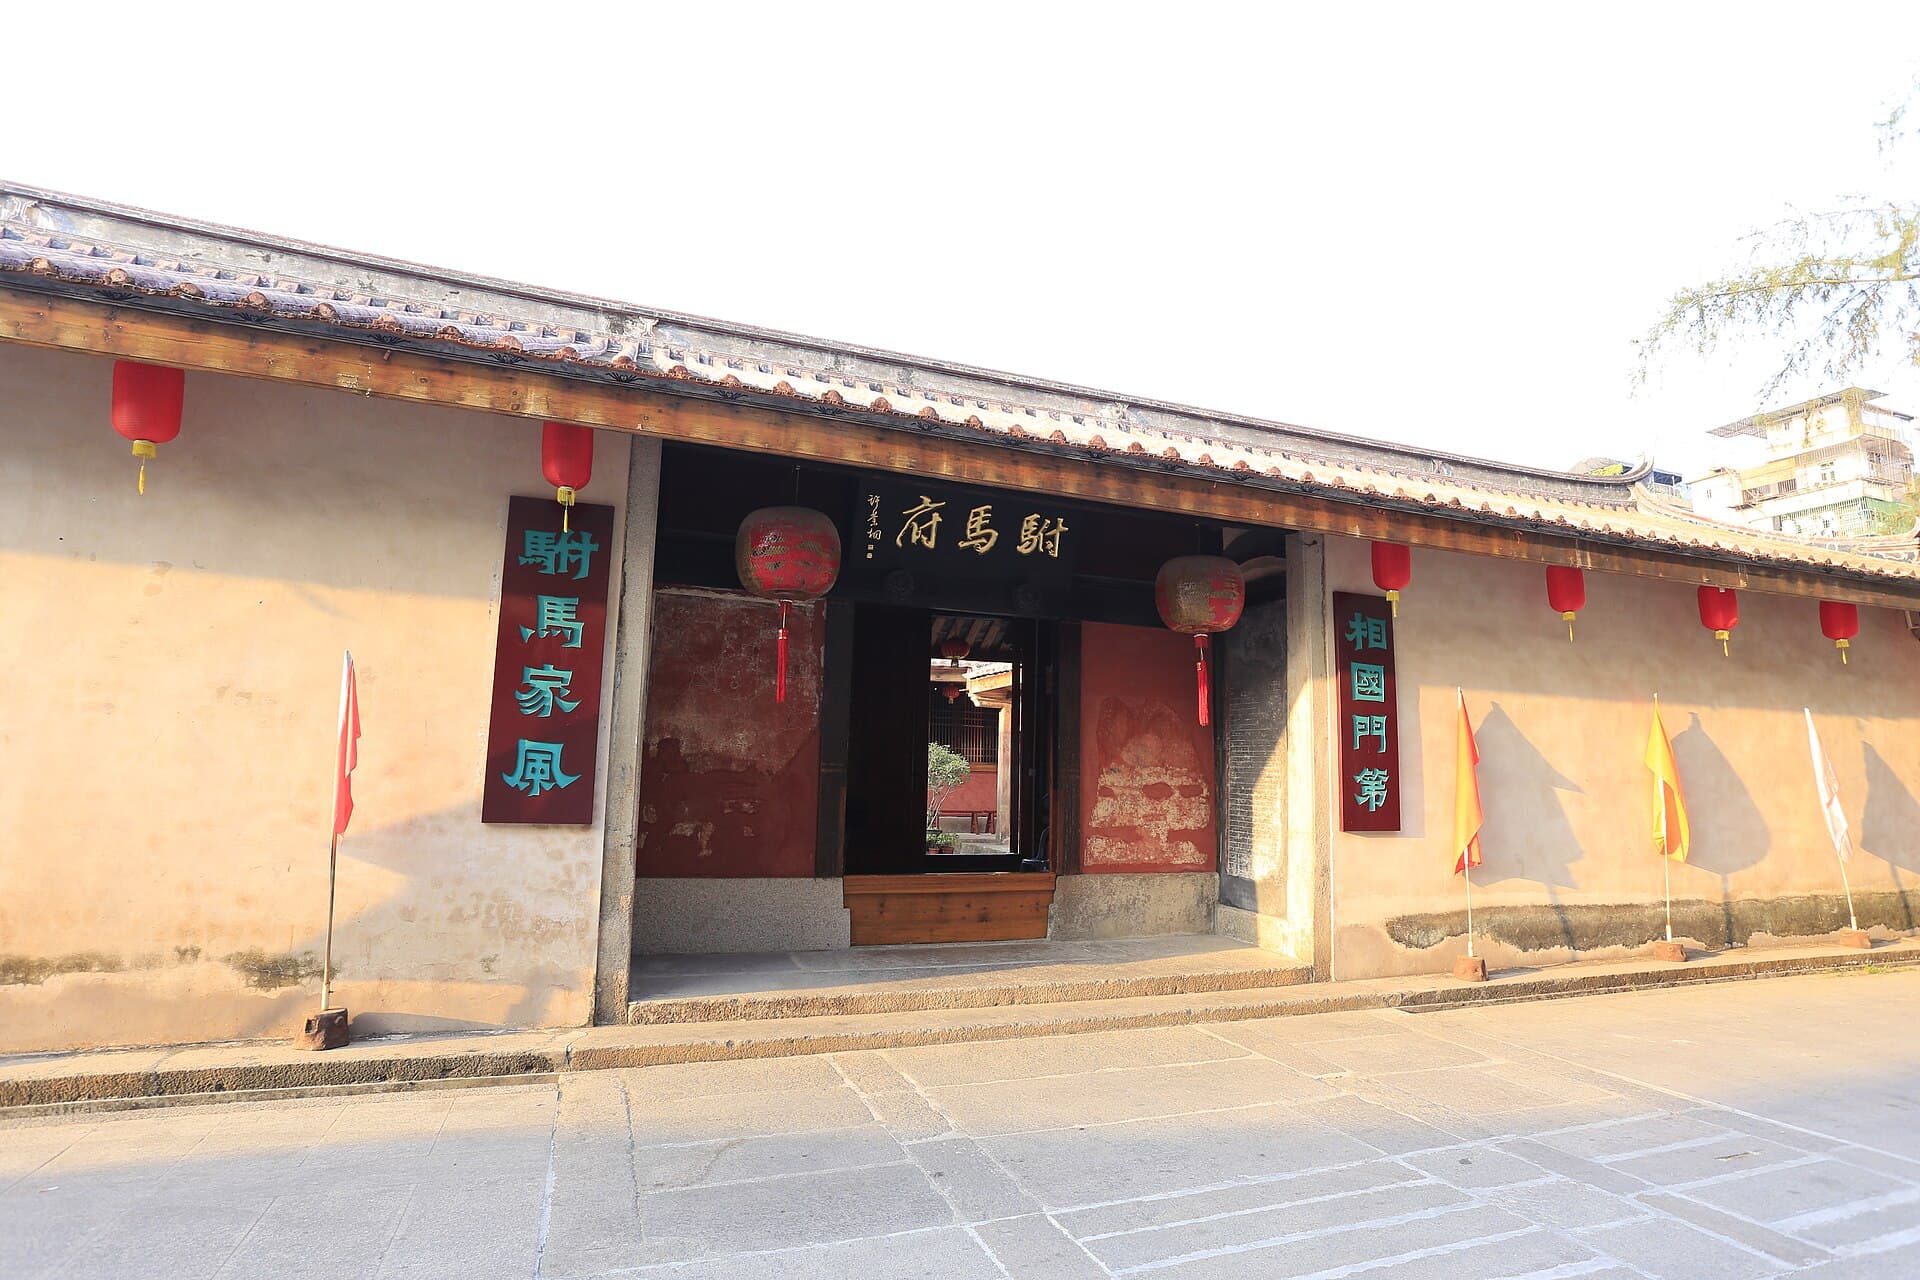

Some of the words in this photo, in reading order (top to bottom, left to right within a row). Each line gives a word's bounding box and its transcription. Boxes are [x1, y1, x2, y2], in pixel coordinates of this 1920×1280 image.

[895, 495, 1069, 558] 駙馬府
[501, 529, 599, 797] 駙馬家風
[1345, 612, 1389, 812] 相國門第
